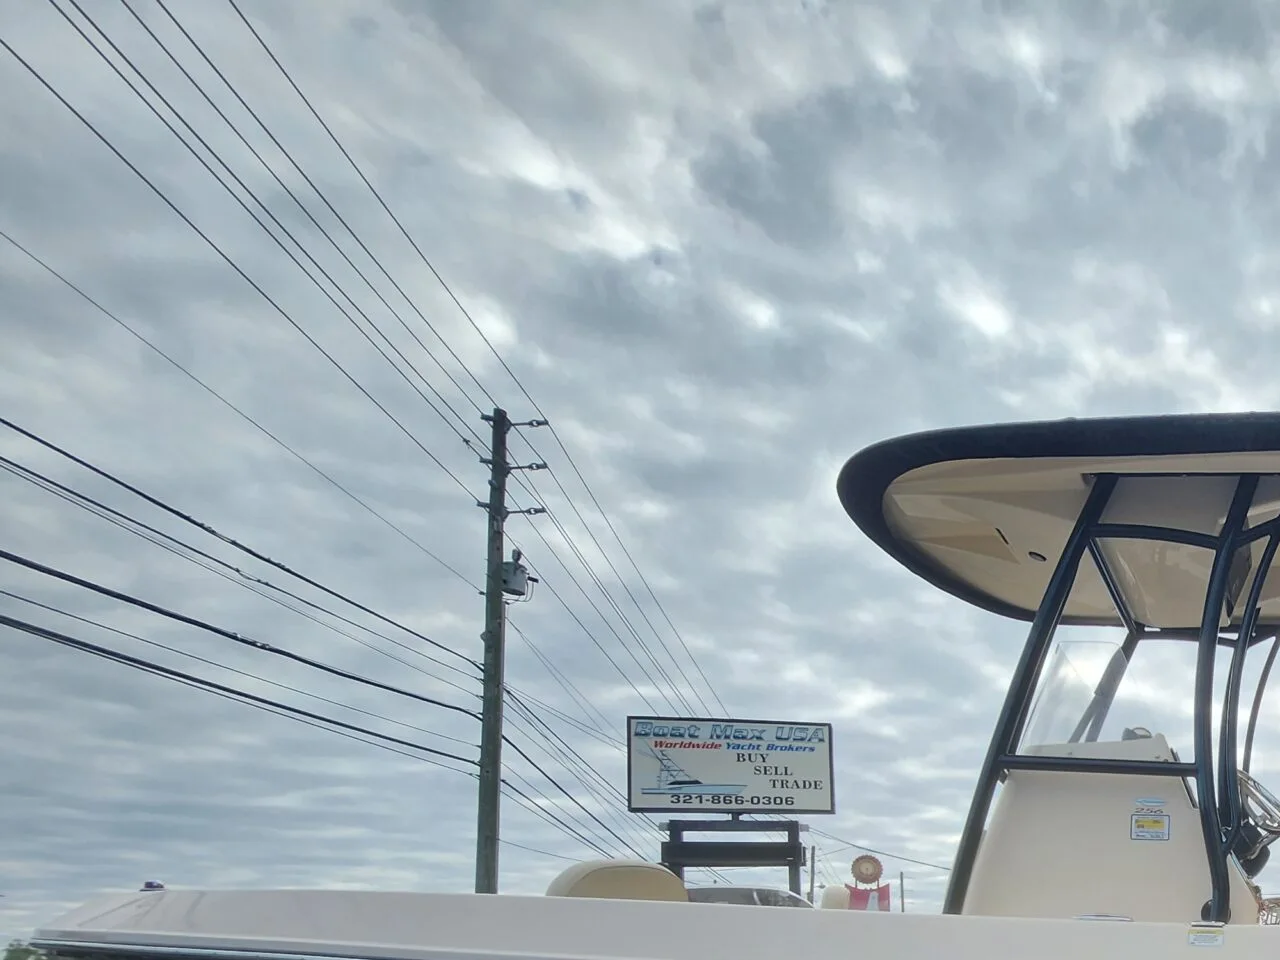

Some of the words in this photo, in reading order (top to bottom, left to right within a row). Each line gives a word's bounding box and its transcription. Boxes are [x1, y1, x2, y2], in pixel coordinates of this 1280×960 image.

[634, 721, 701, 738] Boat
[709, 724, 765, 741] Max
[775, 726, 826, 743] USA
[652, 740, 722, 750] Worldwide
[725, 742, 761, 751] Yacht
[765, 743, 816, 752] Brokers
[736, 753, 769, 763] BUY
[753, 766, 793, 776] SELL
[769, 779, 824, 790] TRADE
[669, 794, 795, 806] 321-866-0306
